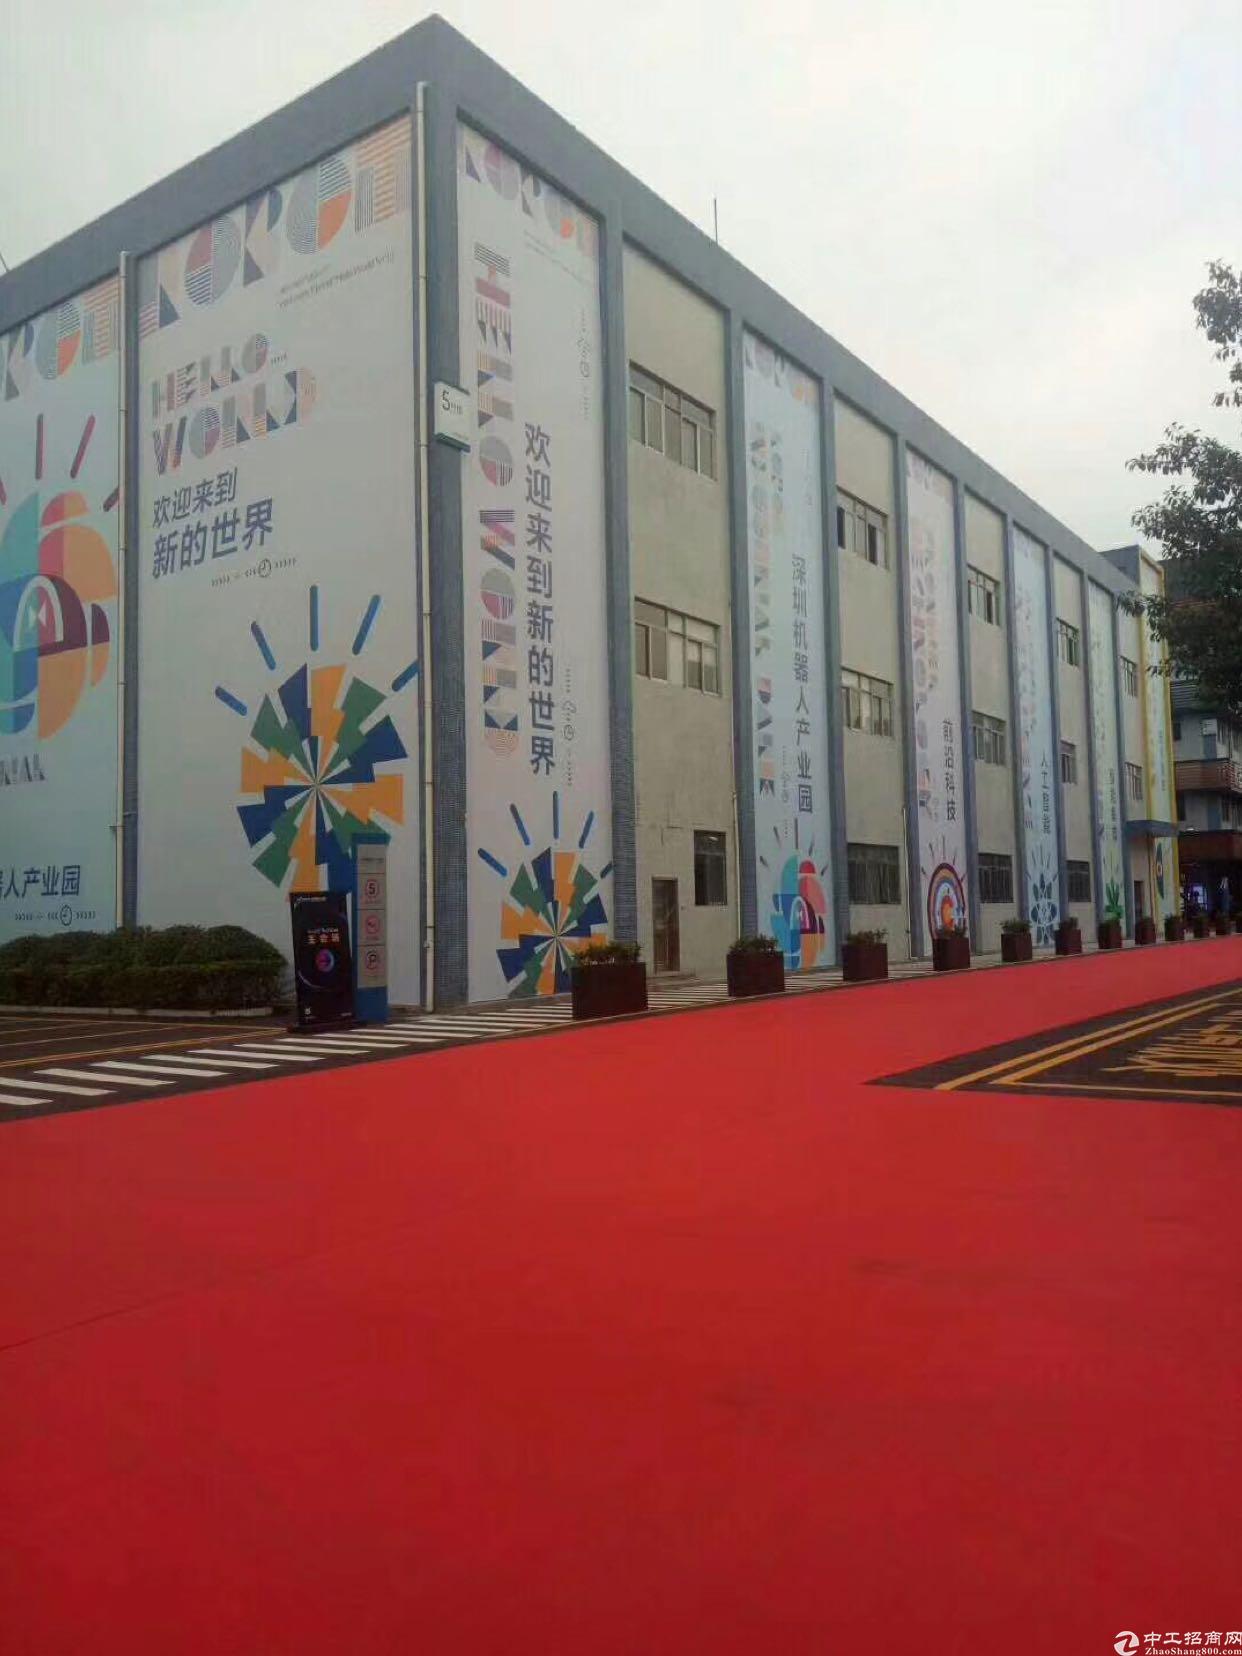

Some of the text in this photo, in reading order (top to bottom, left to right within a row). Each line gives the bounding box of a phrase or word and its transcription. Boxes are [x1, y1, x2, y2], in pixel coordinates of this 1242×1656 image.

[152, 333, 269, 418] HELLO
[153, 367, 317, 475] WORLD
[152, 467, 238, 528] 欢迎来到
[152, 498, 273, 579] 新的世界
[525, 423, 555, 776] 欢迎来到新的世界
[792, 555, 813, 814] 深圳机器人产业园
[0, 865, 81, 899] 人产业园
